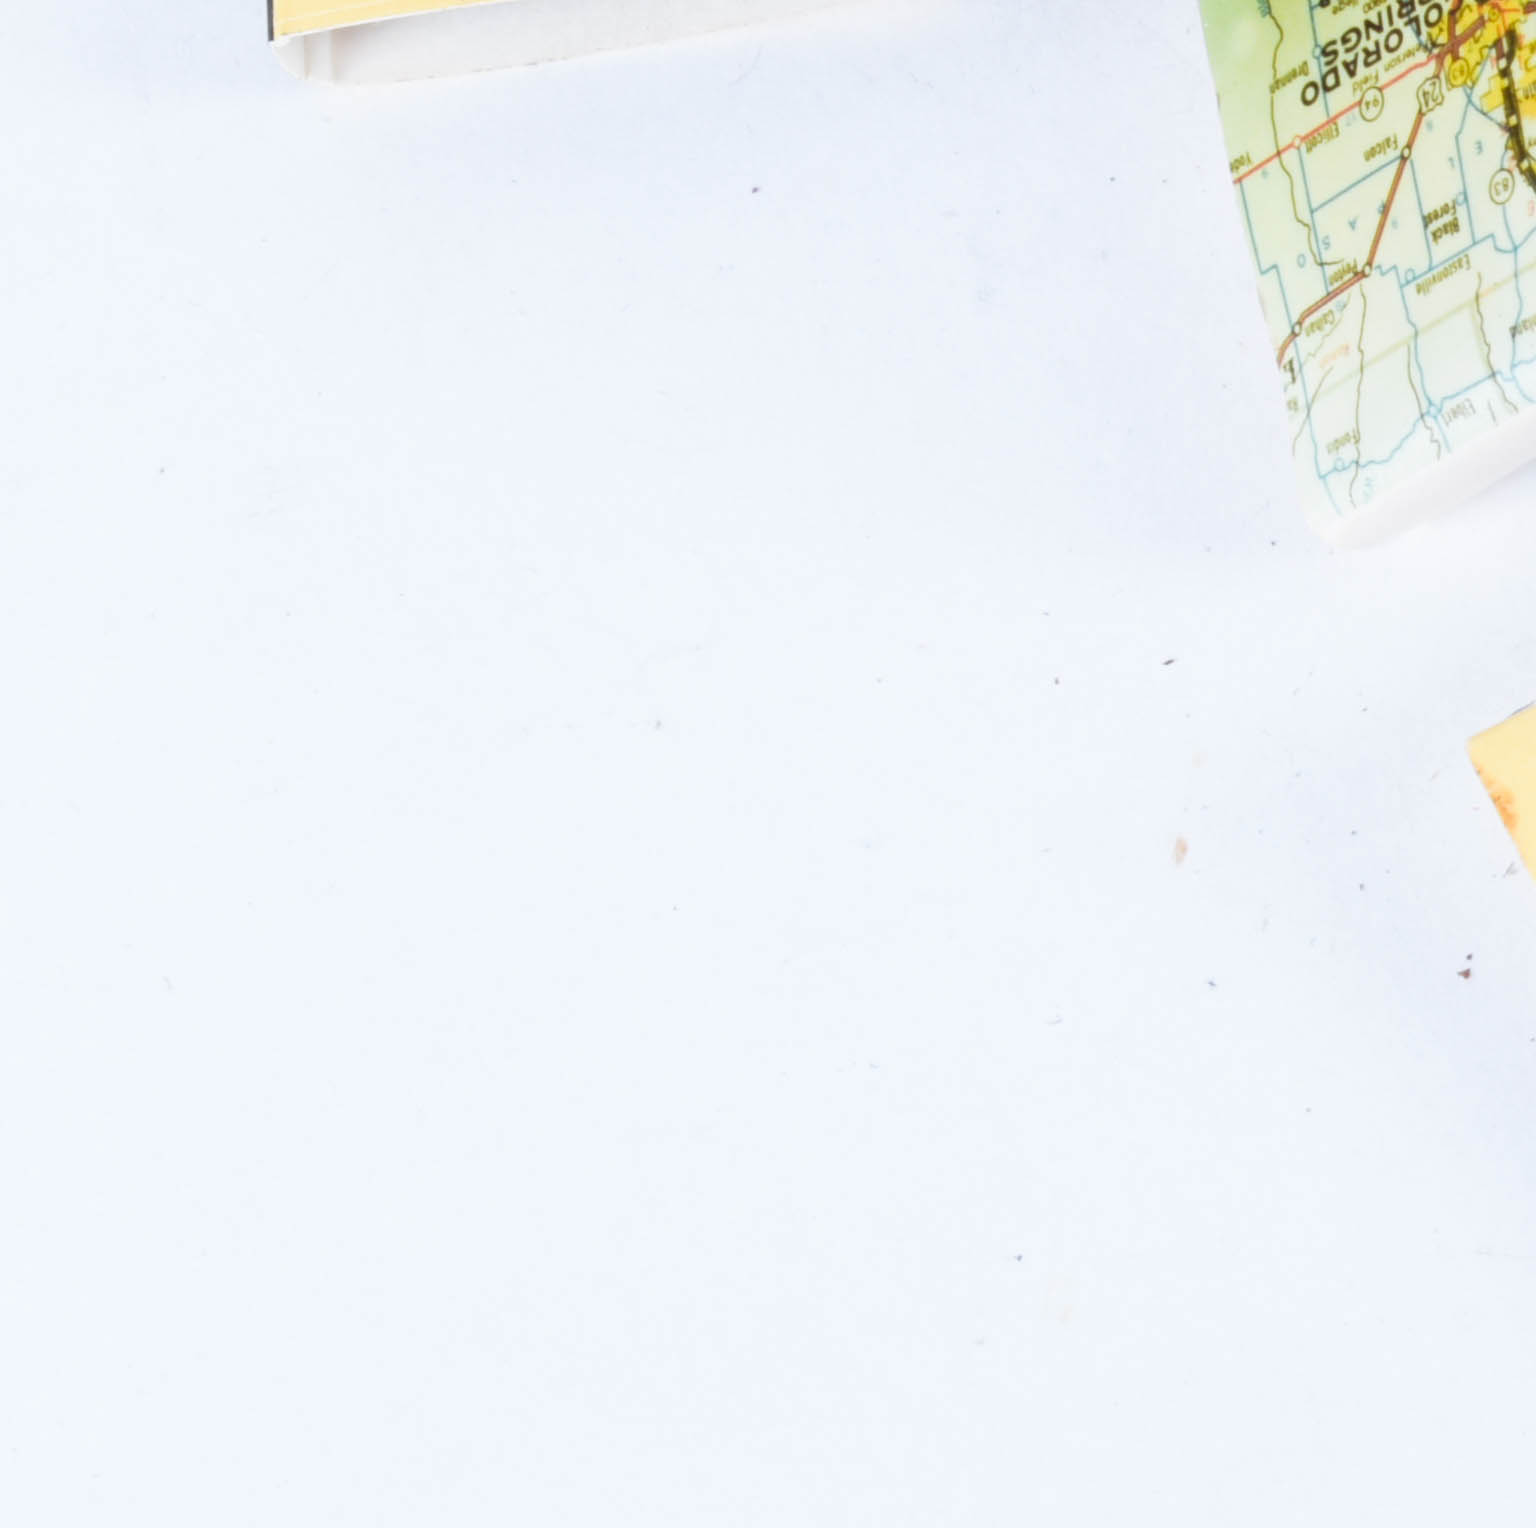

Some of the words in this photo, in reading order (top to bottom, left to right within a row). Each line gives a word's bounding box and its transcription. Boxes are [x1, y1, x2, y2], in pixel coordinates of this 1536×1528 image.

[1415, 81, 1443, 109] 24
[1363, 131, 1399, 165] Falcon
[1421, 197, 1456, 230] Forest
[1431, 215, 1460, 245] Black
